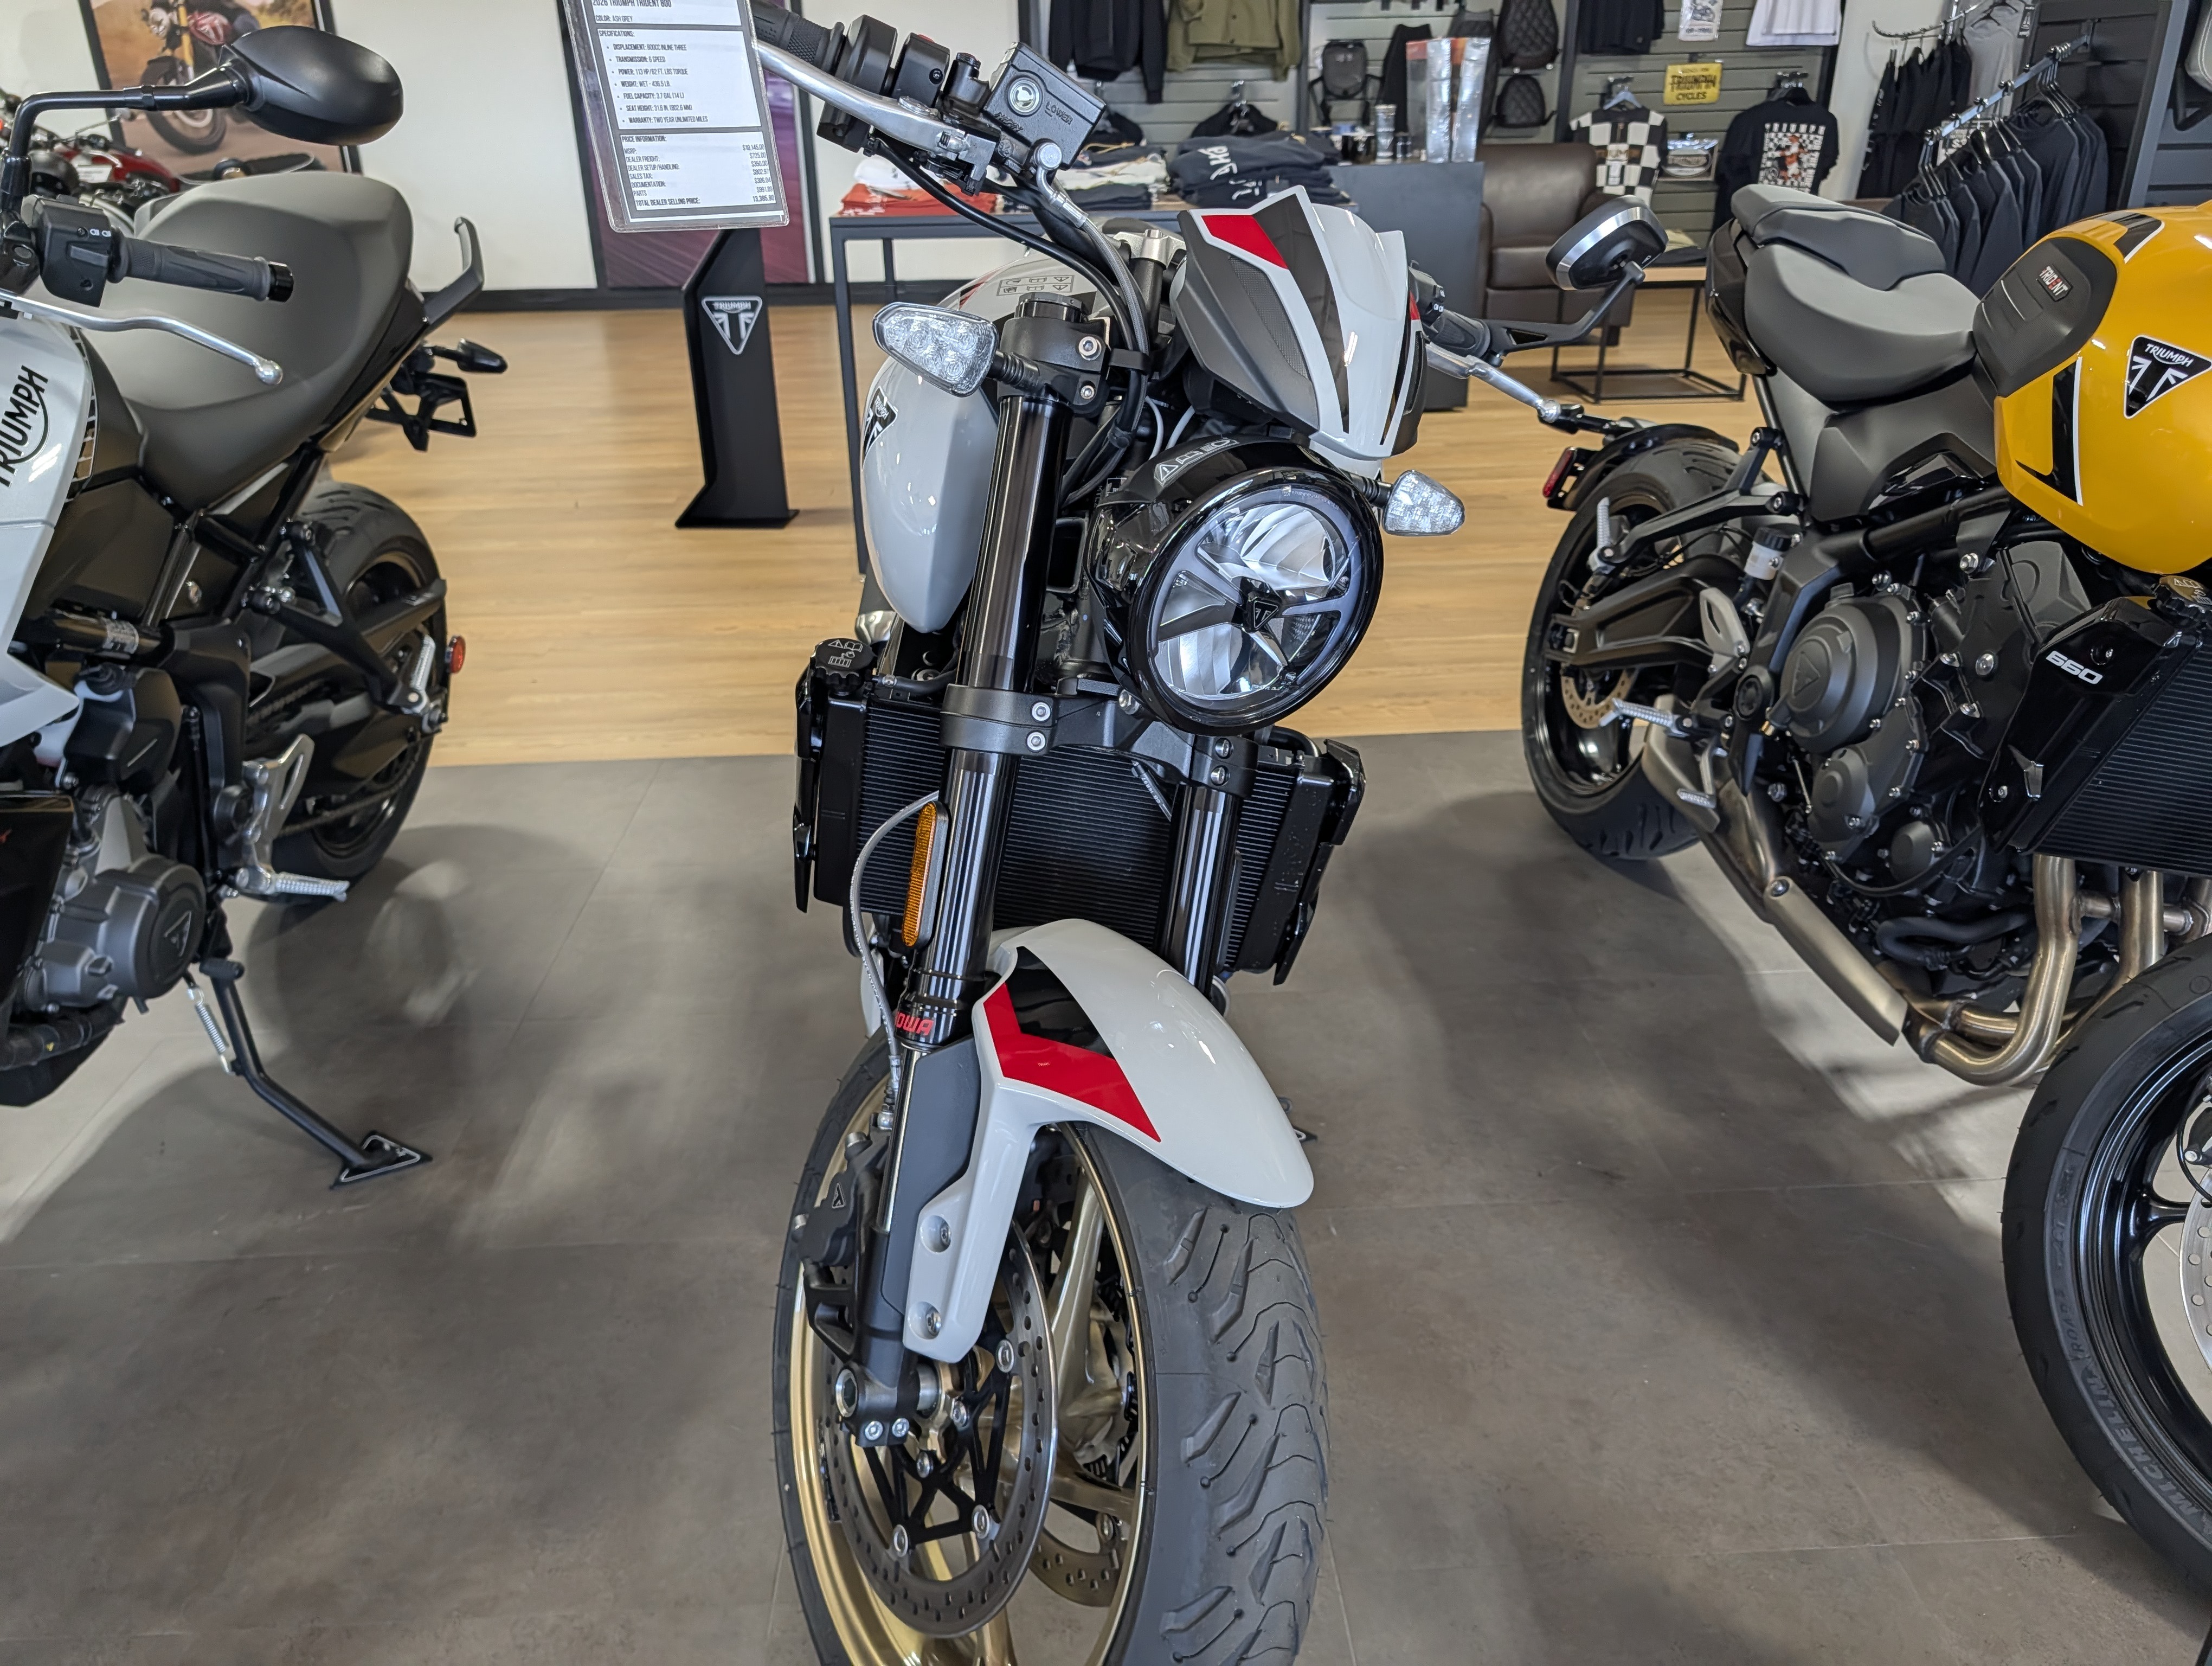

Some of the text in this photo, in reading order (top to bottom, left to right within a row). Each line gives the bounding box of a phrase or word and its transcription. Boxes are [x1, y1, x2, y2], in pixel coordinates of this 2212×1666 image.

[1045, 101, 1073, 125] LOWER
[713, 302, 751, 313] TRIUMPH
[2144, 343, 2194, 367] TRIUMPH
[2046, 650, 2104, 684] 660
[895, 1011, 934, 1036] OWA
[2089, 1377, 2202, 1516] MICHELIN
